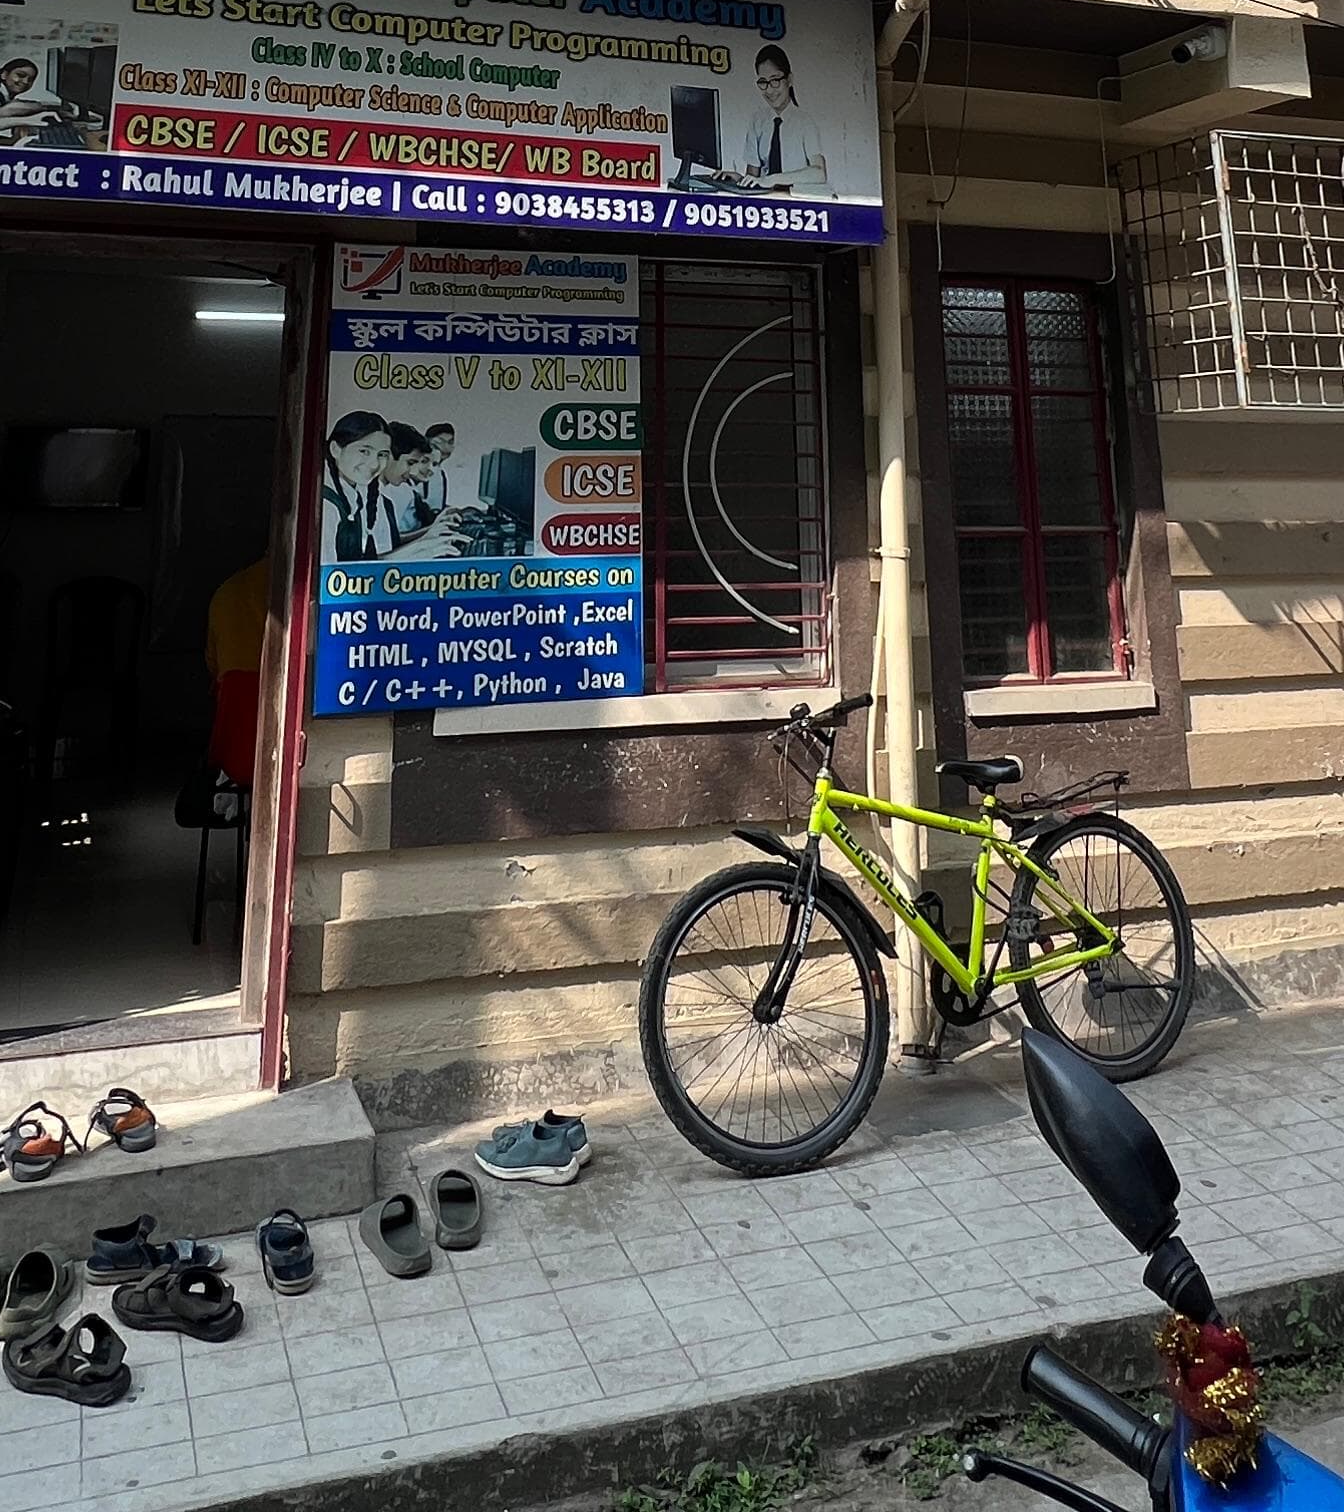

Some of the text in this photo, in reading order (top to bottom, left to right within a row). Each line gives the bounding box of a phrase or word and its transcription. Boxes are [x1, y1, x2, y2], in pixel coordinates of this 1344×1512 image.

[330, 4, 502, 46] Computer
[509, 22, 731, 73] Programming
[253, 38, 560, 90] Class IV to X School Computer
[119, 63, 668, 133] Class XI-XII Computer Science & Computer Application
[126, 114, 216, 151] CBSE
[258, 123, 329, 158] ICSE
[525, 146, 571, 176] WB
[580, 149, 656, 180] Board
[122, 165, 213, 197] Rahul
[225, 172, 382, 212] Mukherjee
[412, 184, 467, 213] Call
[495, 190, 655, 224] 9038455313
[685, 203, 829, 233] 9051933521
[409, 252, 627, 283] Mukherjee Academy
[410, 282, 624, 303] Let's Start Computer Programming
[348, 312, 638, 348] স্কুল কম্পিউটার ক্লাস
[354, 355, 627, 391] Class V to XI-XII
[554, 409, 637, 441] CBSE
[562, 463, 635, 497] ICSE
[549, 524, 640, 547] WBCHSE
[327, 564, 633, 598] Our Computer Courses on
[330, 610, 367, 636] MS
[377, 607, 439, 632] Word,
[449, 604, 567, 629] PowerPoint
[348, 634, 617, 669] HTML MYSQL Scratch
[339, 680, 355, 706] C
[473, 672, 547, 702] Python
[578, 668, 624, 690] Java
[833, 821, 918, 920] HERCULES
